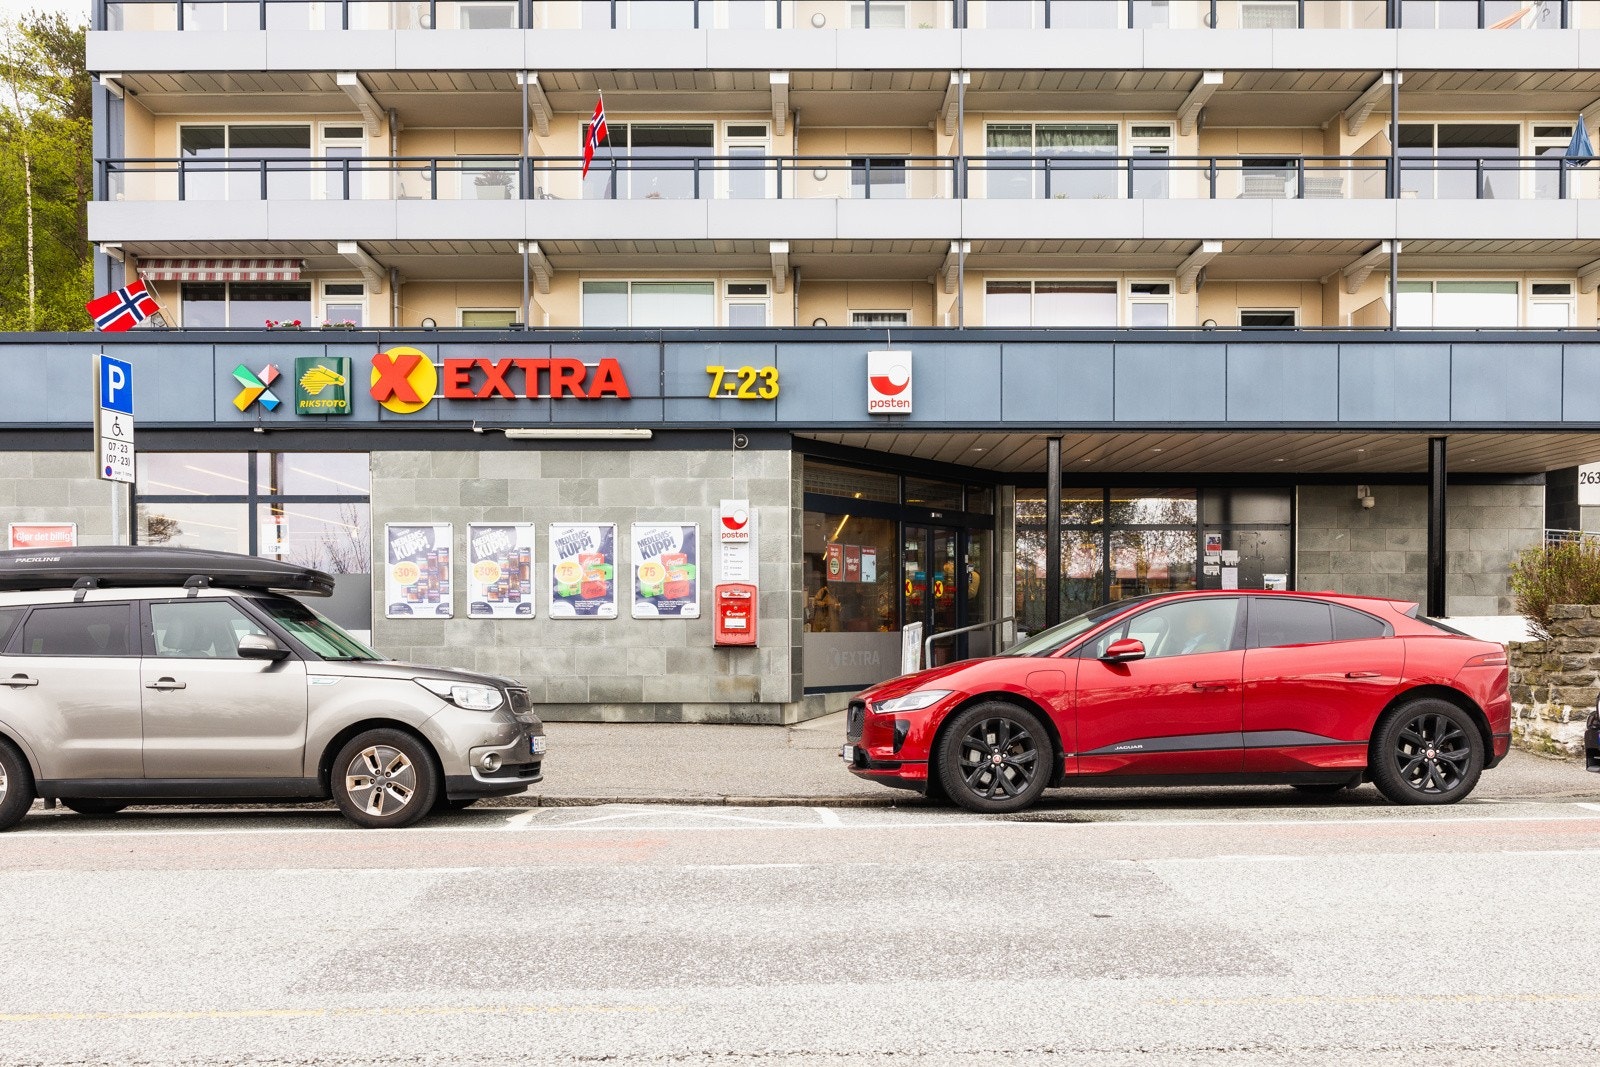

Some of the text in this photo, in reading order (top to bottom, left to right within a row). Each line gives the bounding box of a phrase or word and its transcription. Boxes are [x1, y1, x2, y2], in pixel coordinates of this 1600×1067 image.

[108, 364, 125, 403] P
[370, 354, 632, 404] X EXTRA
[706, 366, 779, 399] 7-23
[300, 399, 347, 408] RIKSTOTO
[870, 398, 910, 410] posten
[1579, 471, 1600, 484] 263
[721, 531, 748, 539] posten
[557, 536, 594, 560] KUPP!
[639, 536, 676, 560] KUPP!
[840, 651, 881, 667] EXTRA
